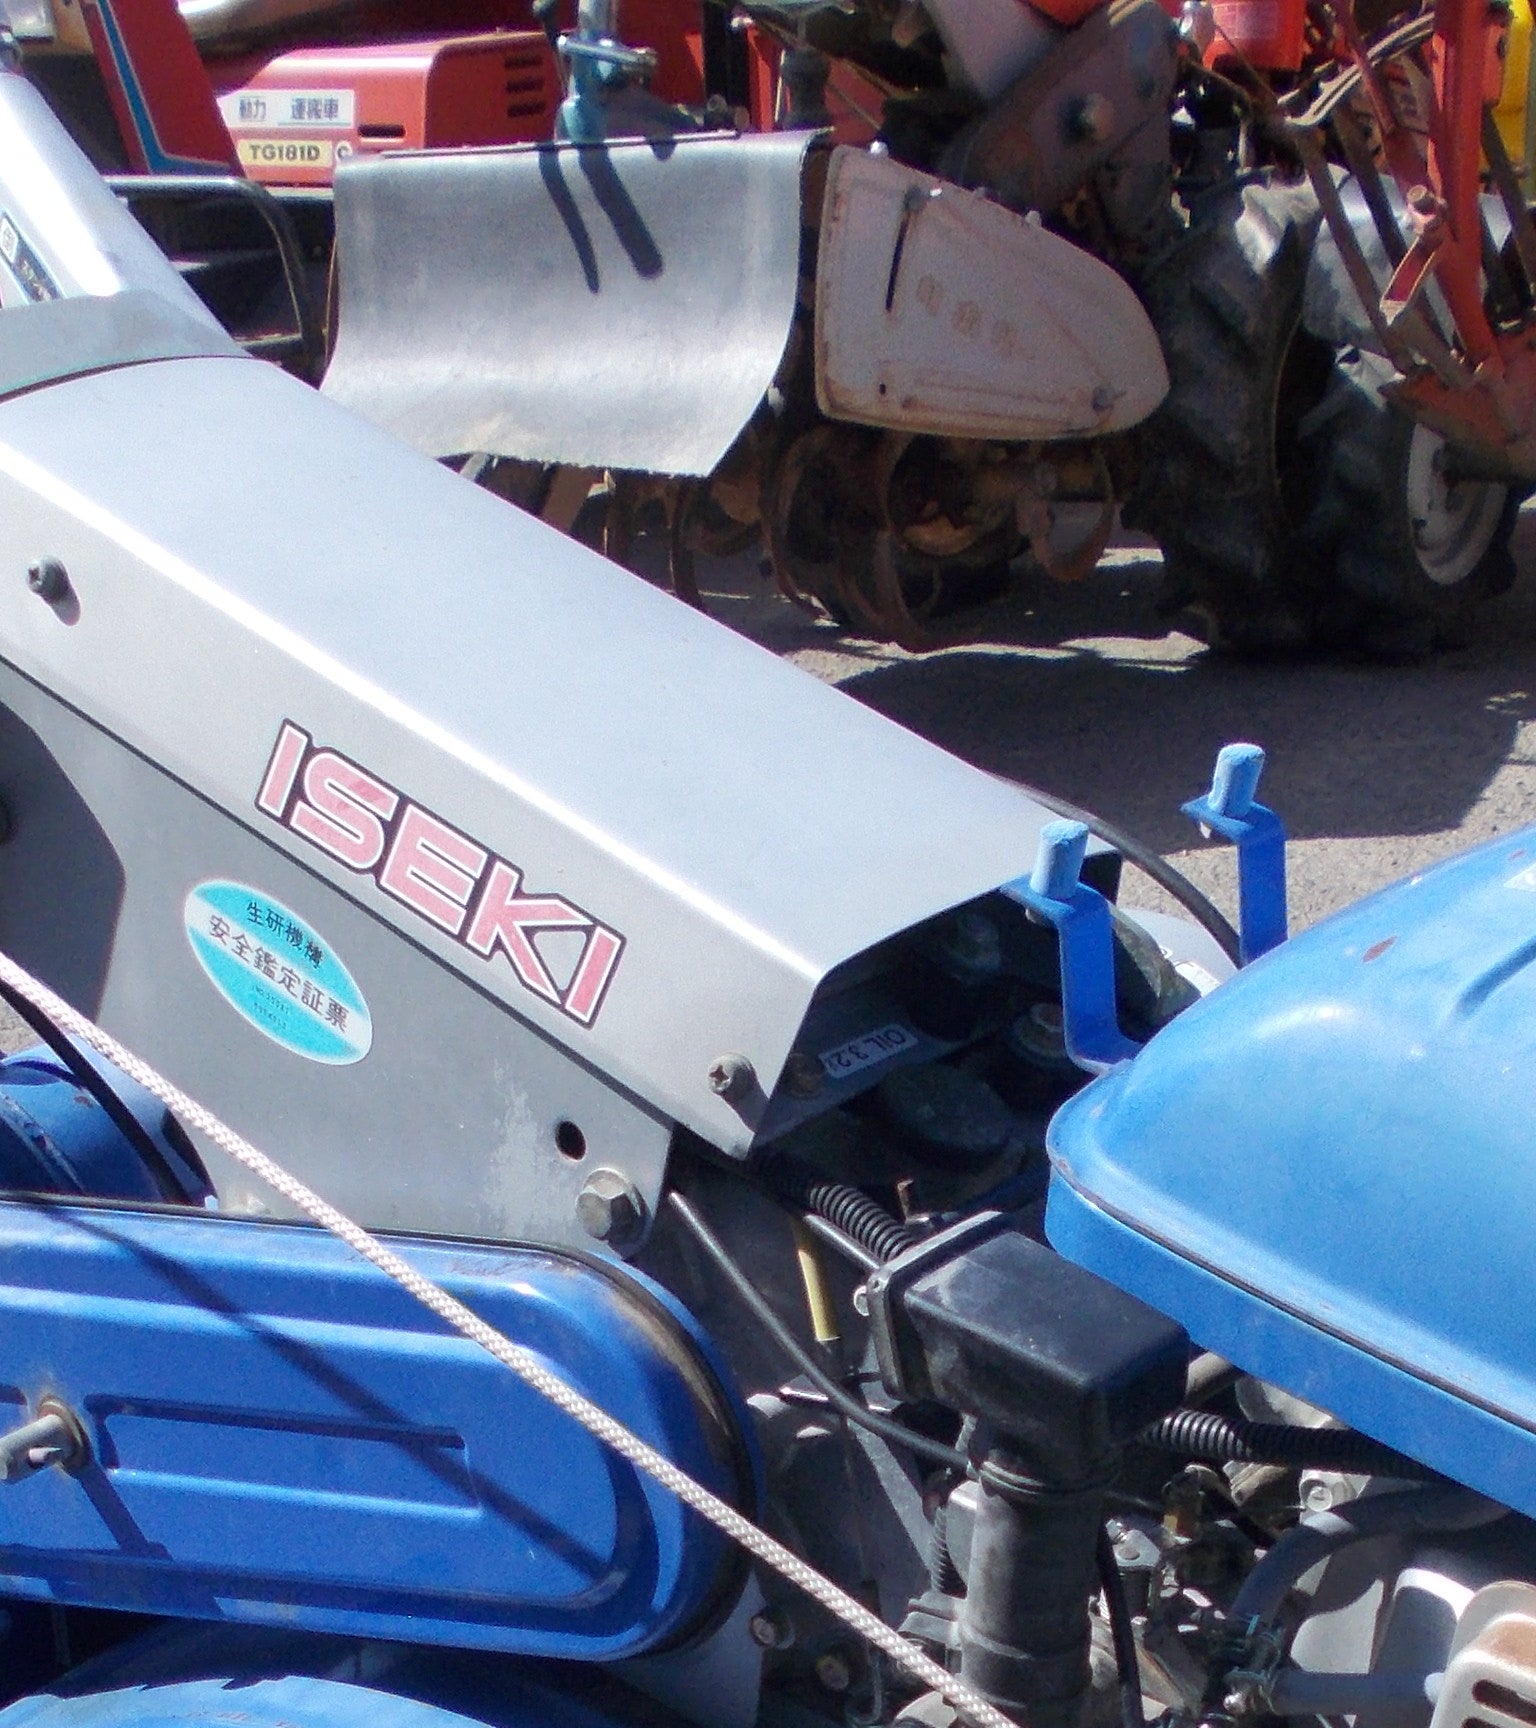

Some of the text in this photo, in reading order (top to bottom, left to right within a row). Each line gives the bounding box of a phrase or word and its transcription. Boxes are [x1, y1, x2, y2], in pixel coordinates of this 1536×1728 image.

[209, 914, 350, 1033] 安全鑑定証票
[255, 718, 627, 1030] ISEKI
